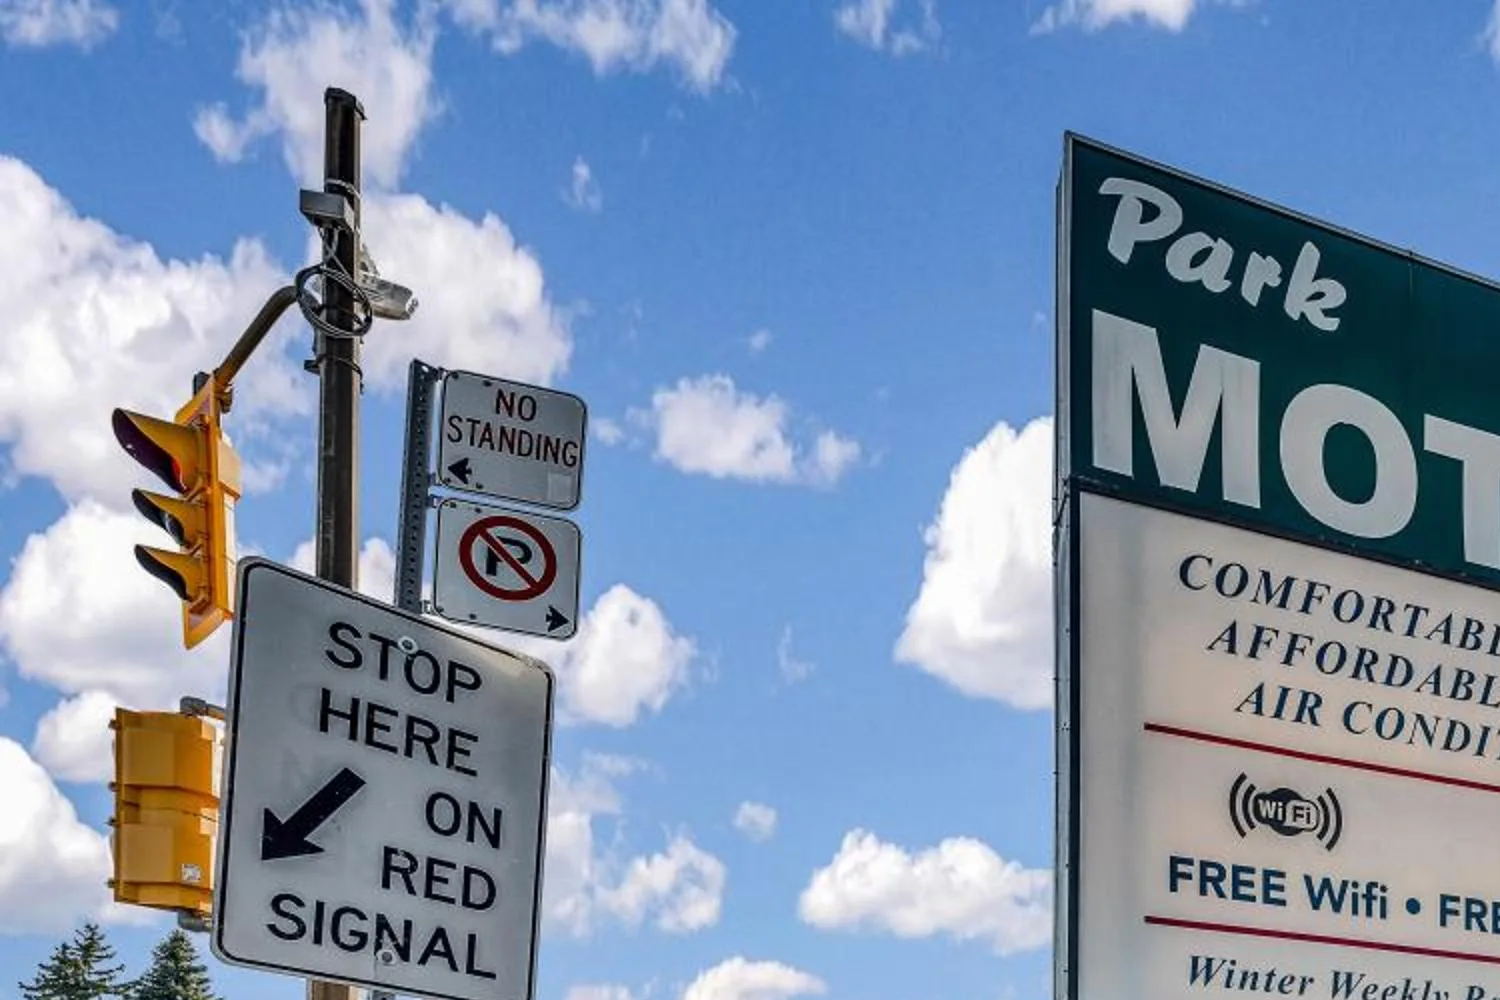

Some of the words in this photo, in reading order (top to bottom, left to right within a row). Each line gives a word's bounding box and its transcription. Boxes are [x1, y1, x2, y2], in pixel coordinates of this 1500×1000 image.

[1099, 176, 1347, 332] Park
[495, 388, 537, 422] NO
[447, 416, 579, 467] STANDING
[325, 621, 481, 703] STOP
[319, 687, 479, 777] HERE
[1235, 682, 1323, 727] AIR
[425, 791, 502, 849] ON
[381, 845, 497, 911] RED
[1169, 855, 1287, 907] FREE
[1303, 874, 1388, 920] Wifi
[266, 893, 497, 980] SIGNAL
[1188, 954, 1314, 997] Winter
